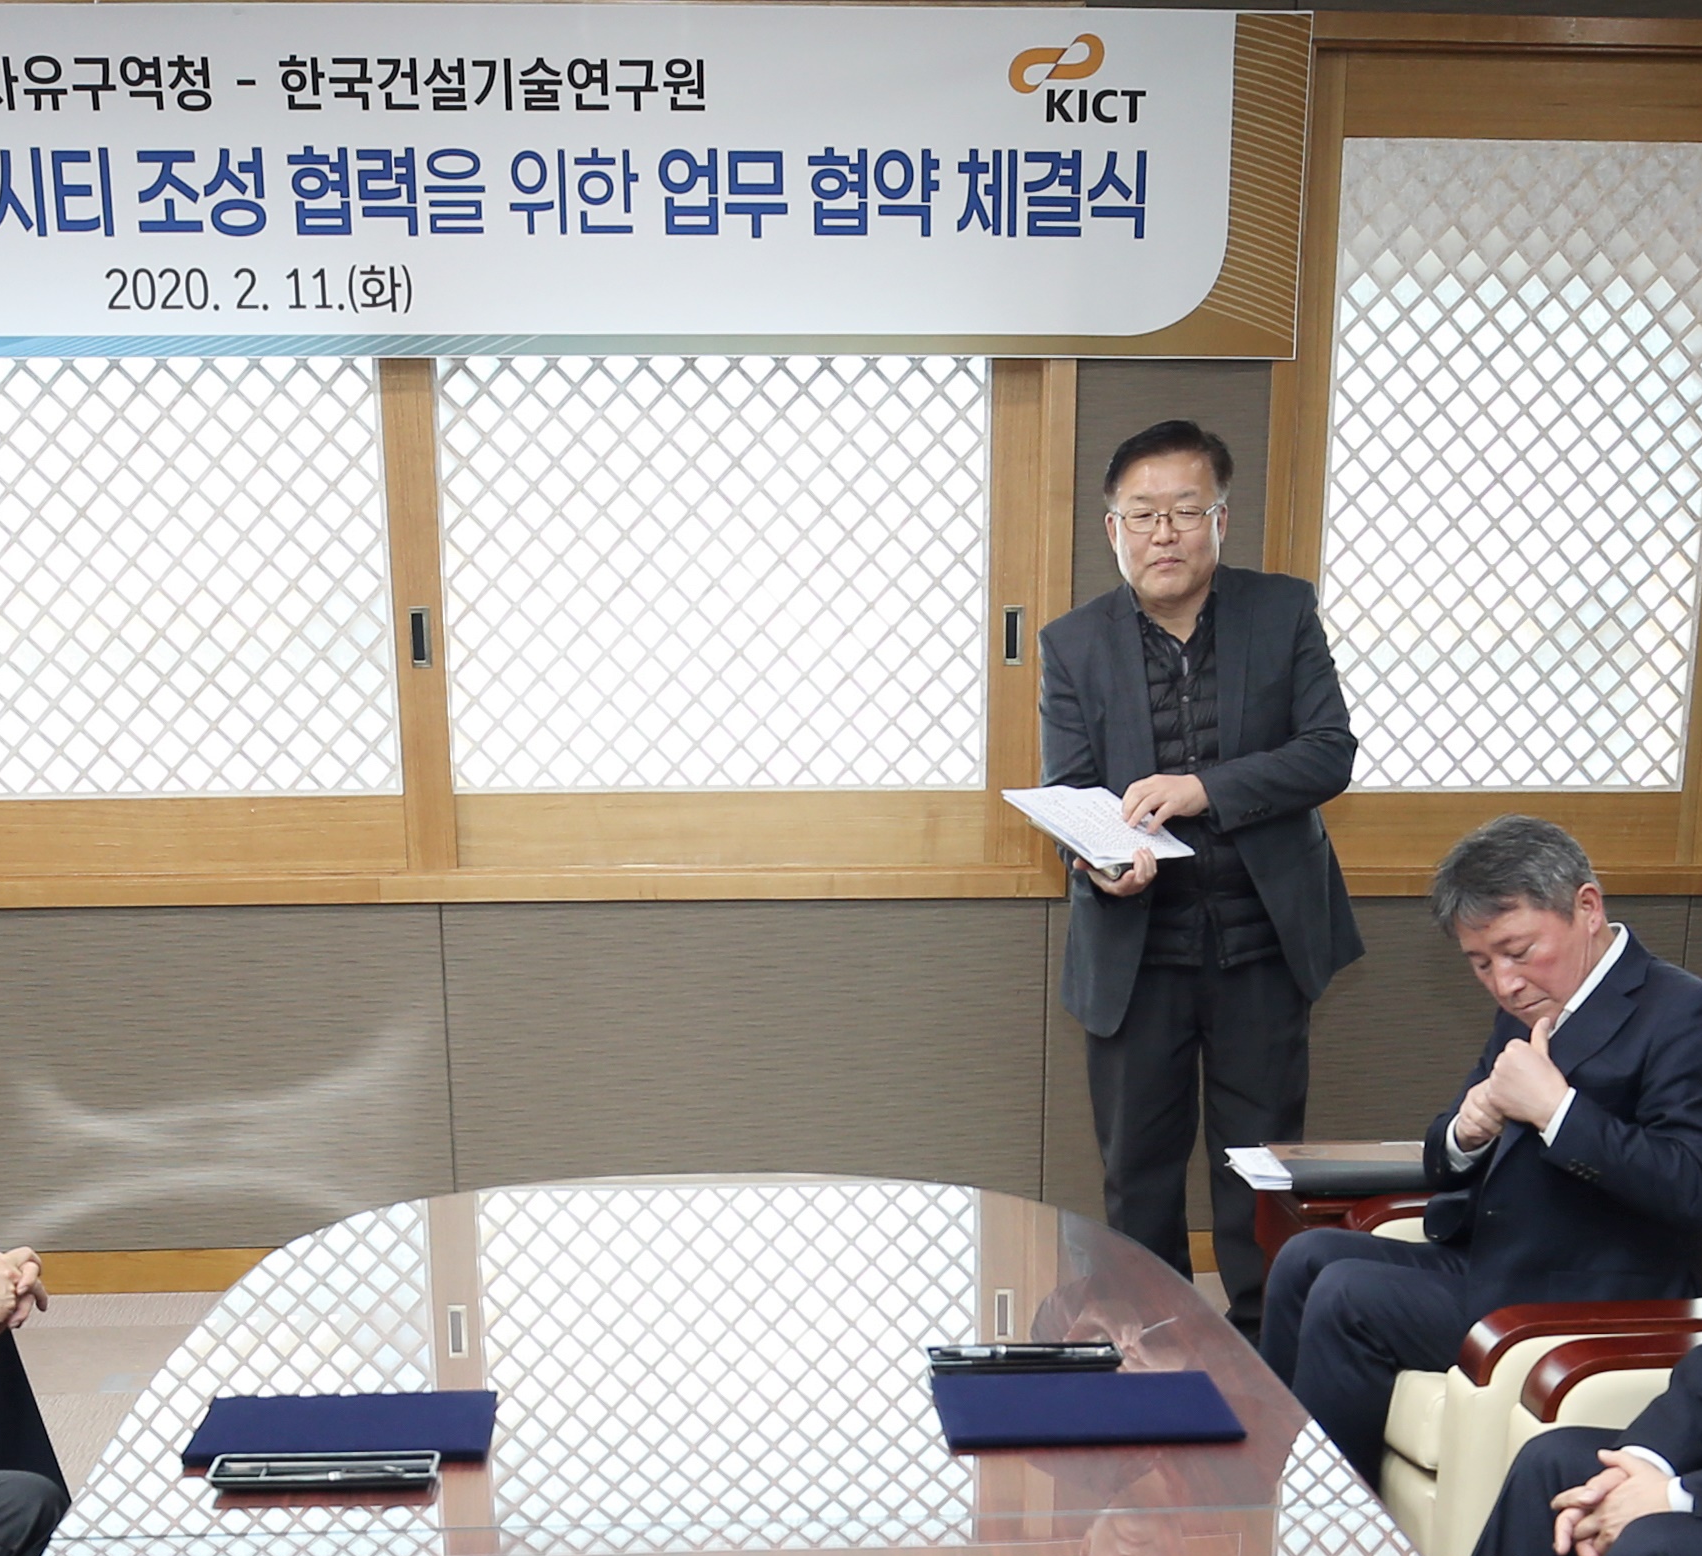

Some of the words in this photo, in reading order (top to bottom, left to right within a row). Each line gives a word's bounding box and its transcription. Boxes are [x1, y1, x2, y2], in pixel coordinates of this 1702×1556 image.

[278, 54, 708, 114] 한국건설기술연구원
[1044, 89, 1149, 124] KICT
[135, 146, 268, 240] 조성
[286, 144, 488, 239] 협력을
[508, 147, 641, 238] 위한
[657, 147, 791, 240] 업무
[807, 146, 943, 240] 협약
[956, 148, 1150, 241] 체결식
[104, 267, 222, 314] 2020.
[233, 267, 271, 314] 2.
[285, 264, 415, 316] 11.(화)
